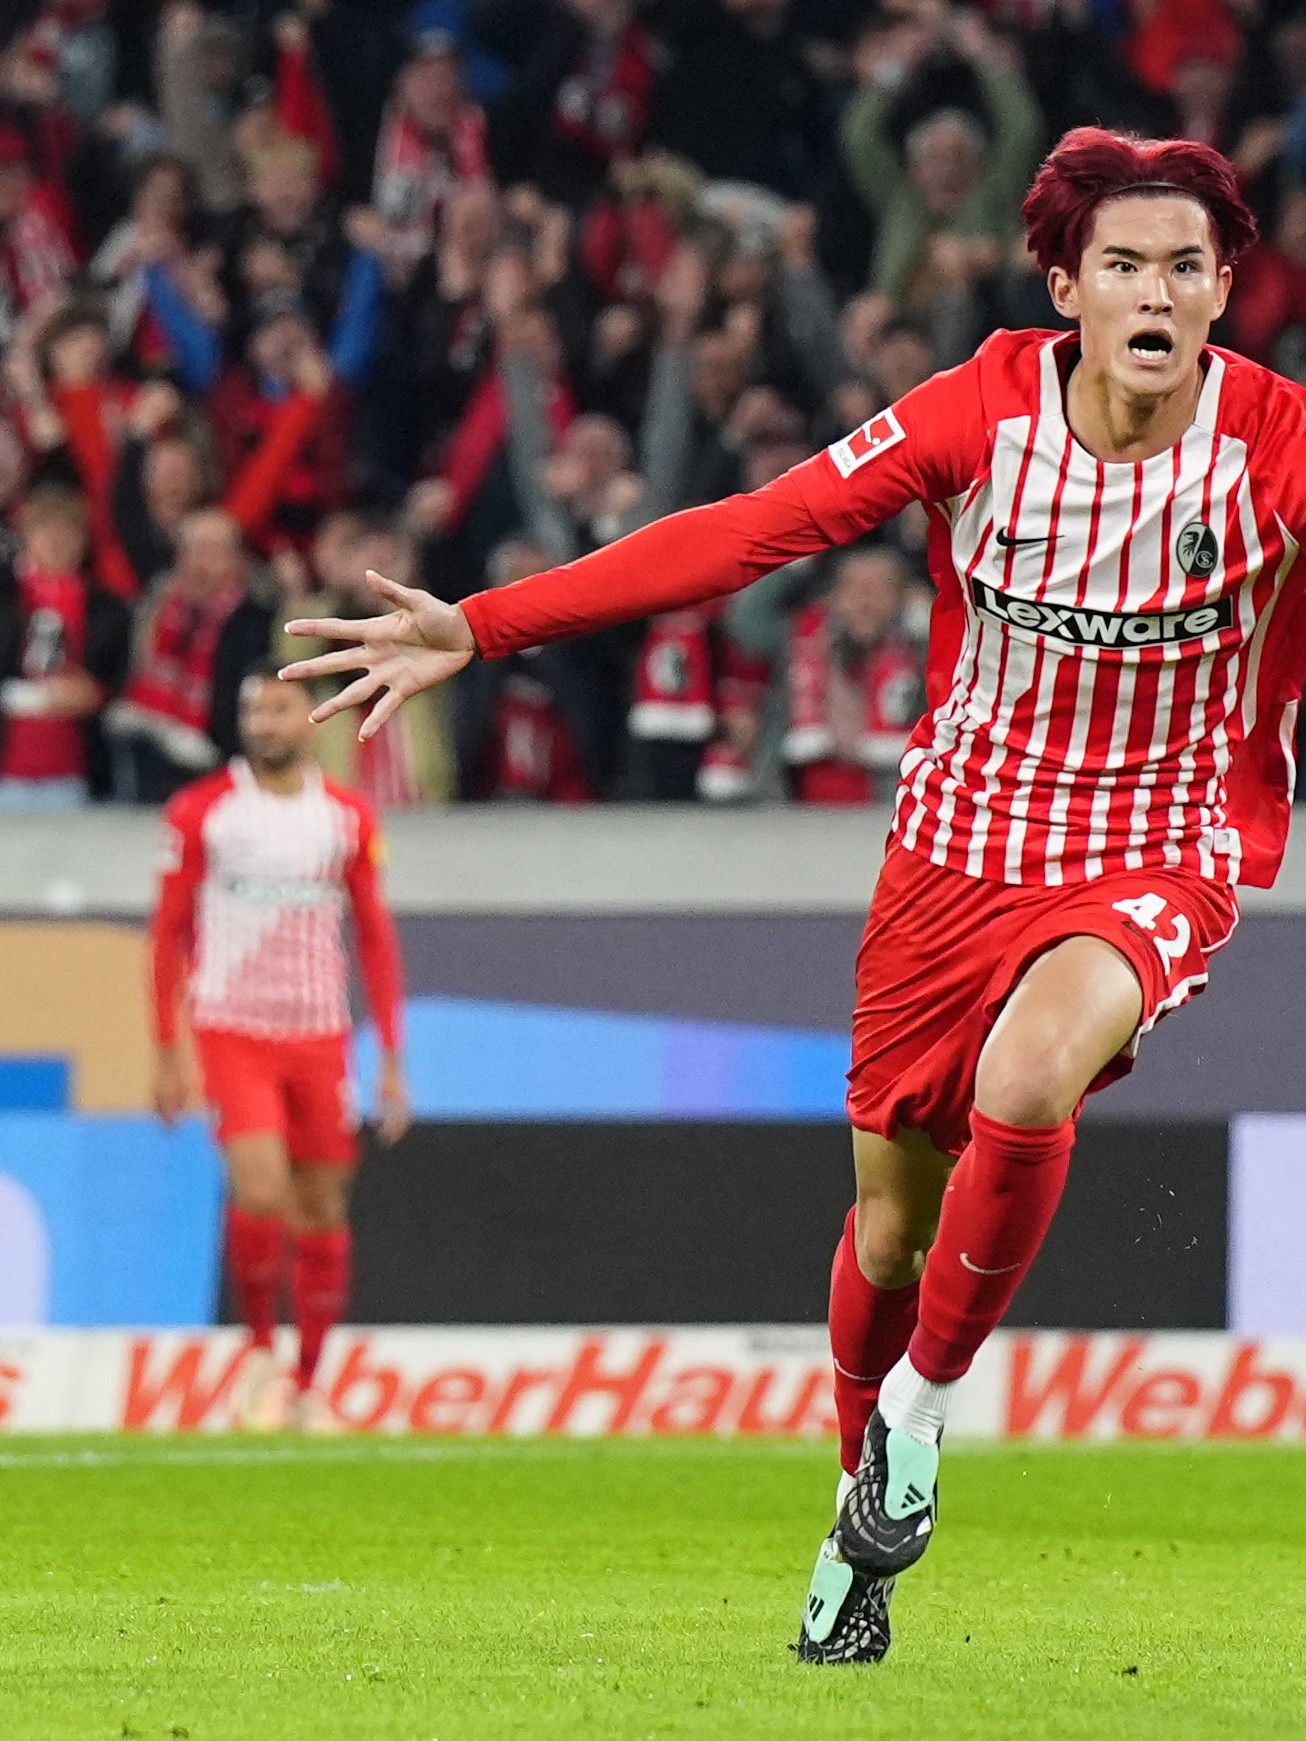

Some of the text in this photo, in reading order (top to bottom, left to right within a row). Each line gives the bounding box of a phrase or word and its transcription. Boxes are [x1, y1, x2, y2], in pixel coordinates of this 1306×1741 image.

[983, 586, 1219, 645] Lexware
[1111, 892, 1191, 977] 42
[122, 1334, 838, 1432] WberHau
